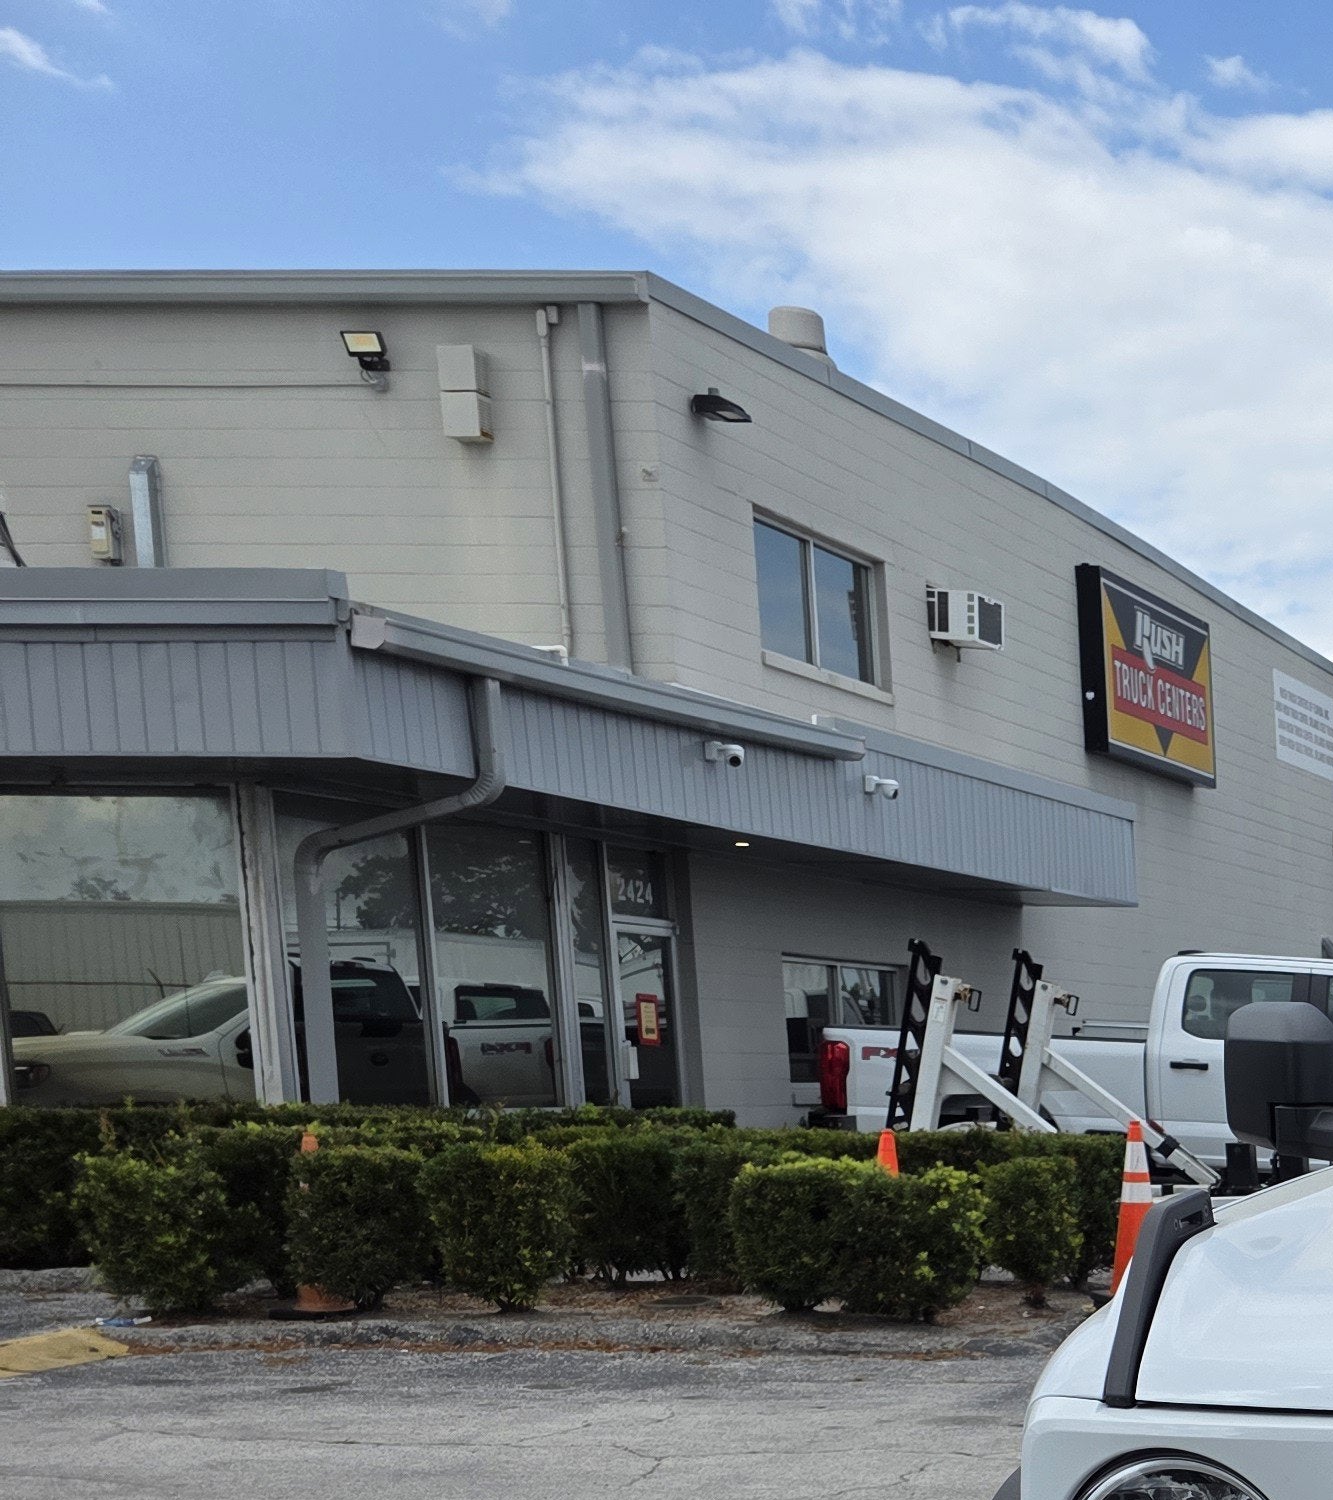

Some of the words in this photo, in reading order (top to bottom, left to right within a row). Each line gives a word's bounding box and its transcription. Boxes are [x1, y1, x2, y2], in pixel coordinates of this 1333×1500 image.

[1114, 659, 1155, 710] TRUCK
[1157, 678, 1206, 730] CENTERS
[616, 877, 653, 905] 2424
